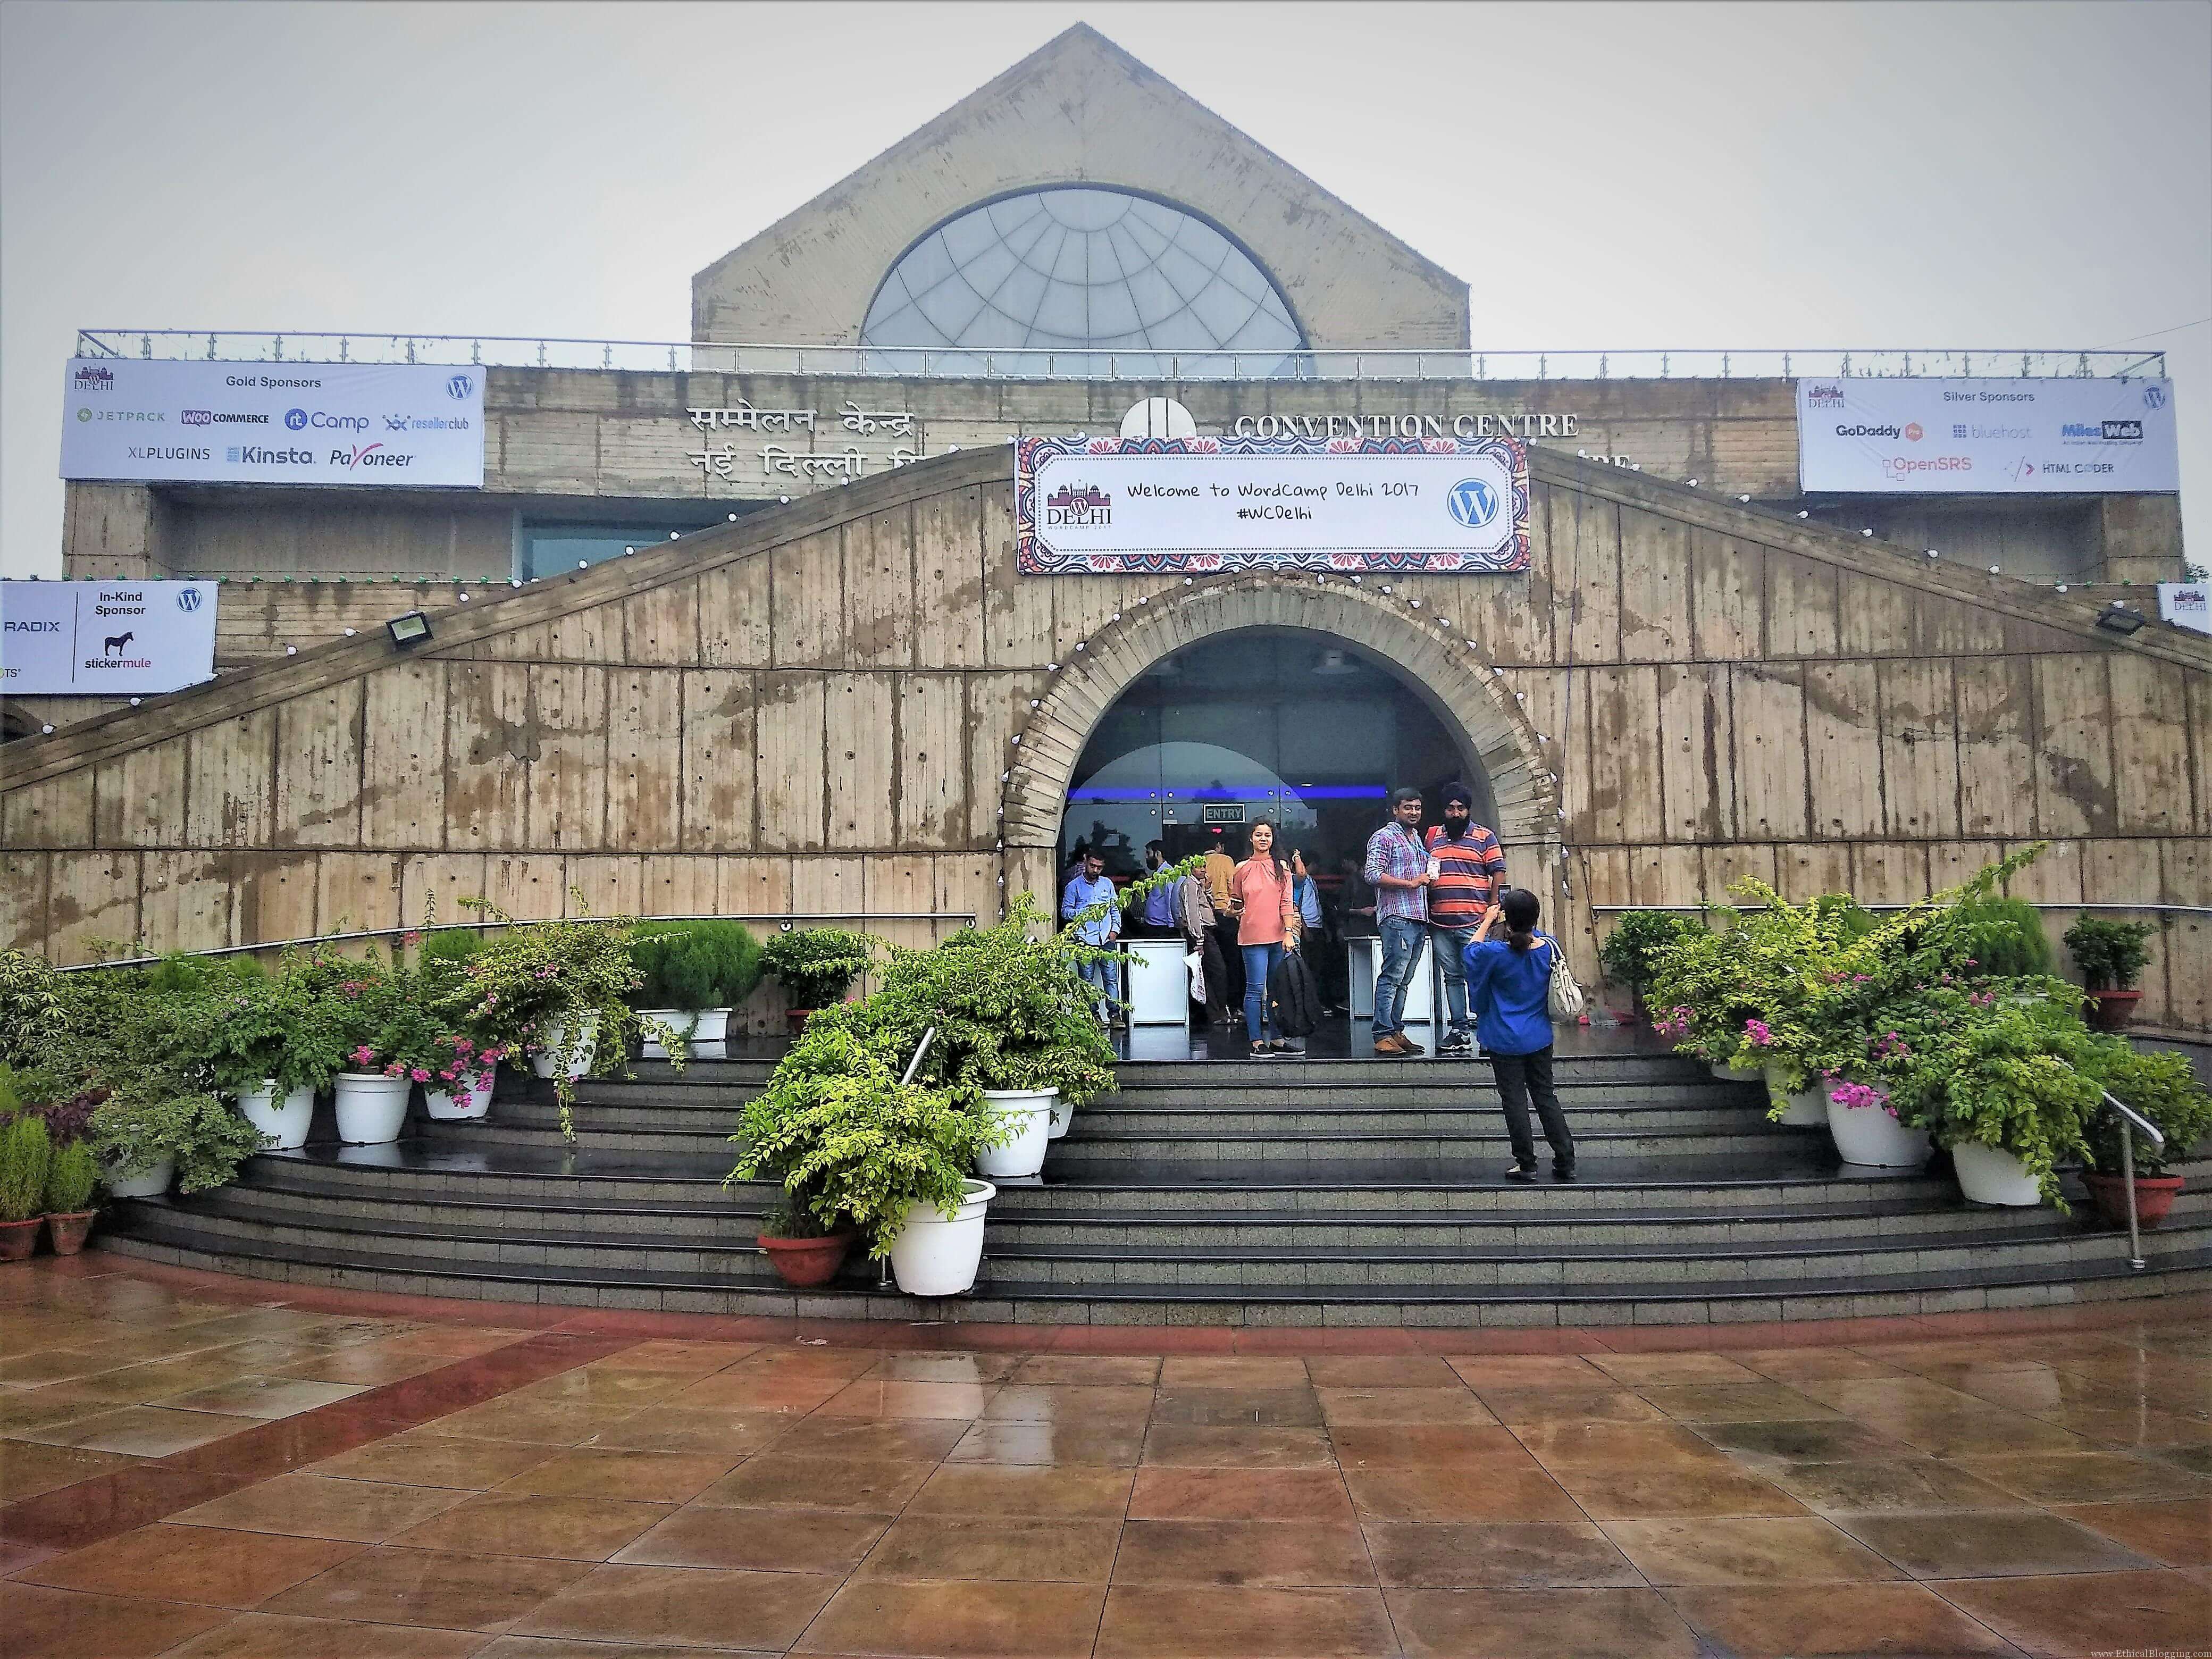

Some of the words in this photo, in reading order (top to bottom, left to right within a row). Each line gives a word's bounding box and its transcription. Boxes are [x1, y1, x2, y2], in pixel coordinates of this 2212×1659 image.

[74, 380, 114, 391] DELHI
[226, 375, 256, 387] Gold
[260, 376, 321, 389] Sponsors
[1943, 391, 1976, 401] Silver
[1980, 391, 2035, 403] Sponsors
[97, 411, 165, 422] JETPACK
[412, 417, 469, 430] resellerclub
[686, 399, 817, 433] सम्मेलन
[836, 400, 915, 438] केन्द्र
[1234, 414, 1444, 438] CONVENTION
[1453, 414, 1581, 438] CENTRE
[1836, 425, 1901, 440] GoDaddy
[1972, 424, 2033, 439] bluehost
[128, 447, 210, 460] XLPLUGINS
[242, 446, 314, 464] Kinsta
[686, 442, 736, 480] नई
[758, 445, 868, 477] दिल्ली
[1893, 456, 1972, 473] OpenSRS
[2043, 464, 2072, 473] HTML
[1127, 482, 1200, 497] Welcome
[1209, 482, 1230, 497] to
[1238, 482, 1327, 501] WordCamp
[1336, 482, 1373, 497] Delhi
[1381, 482, 1419, 497] 2017
[1046, 508, 1113, 525] DELHI
[1236, 505, 1312, 520] #WCDelhi
[99, 591, 143, 602] In-Kind
[95, 605, 146, 617] Sponsor
[4, 621, 60, 632] RADIX
[85, 657, 152, 669] stickermule
[1206, 808, 1243, 819] ENTRY
